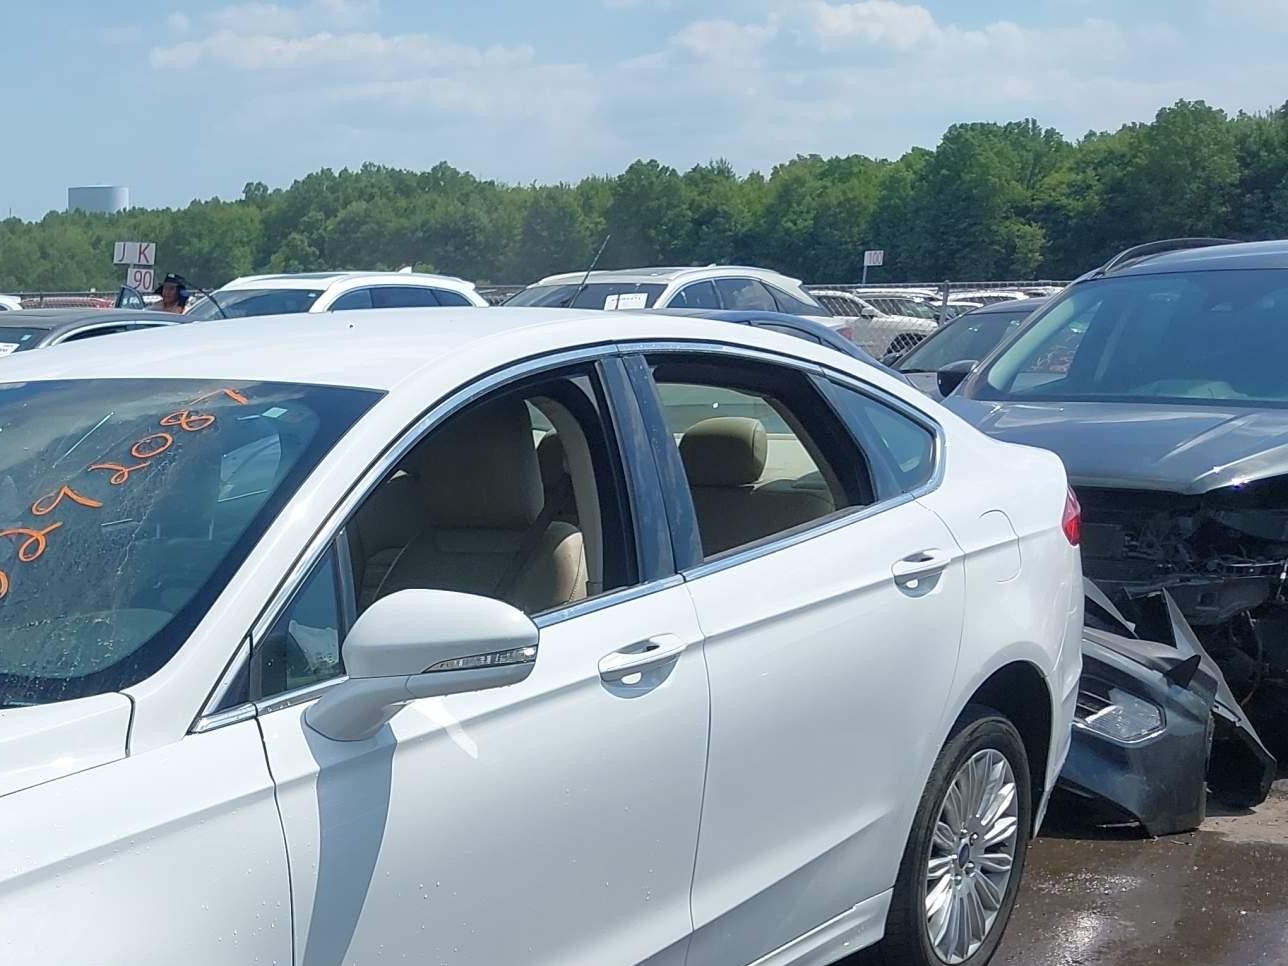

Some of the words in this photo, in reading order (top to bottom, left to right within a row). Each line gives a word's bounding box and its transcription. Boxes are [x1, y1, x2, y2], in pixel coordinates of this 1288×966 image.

[117, 243, 126, 262] J
[138, 243, 150, 263] K
[133, 270, 152, 290] 90
